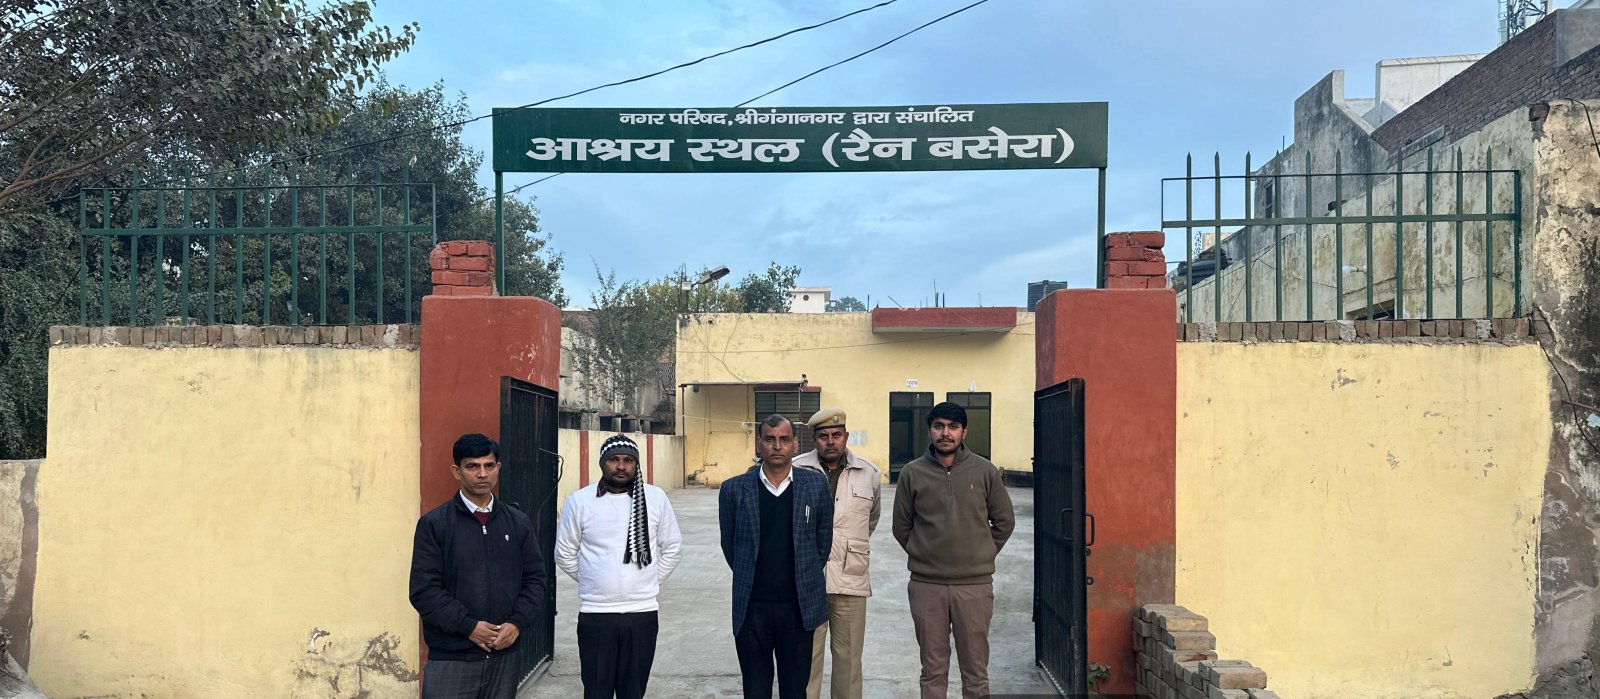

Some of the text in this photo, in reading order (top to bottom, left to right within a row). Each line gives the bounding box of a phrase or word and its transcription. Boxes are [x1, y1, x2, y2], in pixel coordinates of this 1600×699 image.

[619, 106, 975, 126] नगर परिषद, श्रीगंगानगर द्वारा संचालित
[526, 126, 1075, 168] आश्रय स्थल (रैन बसेरा)
